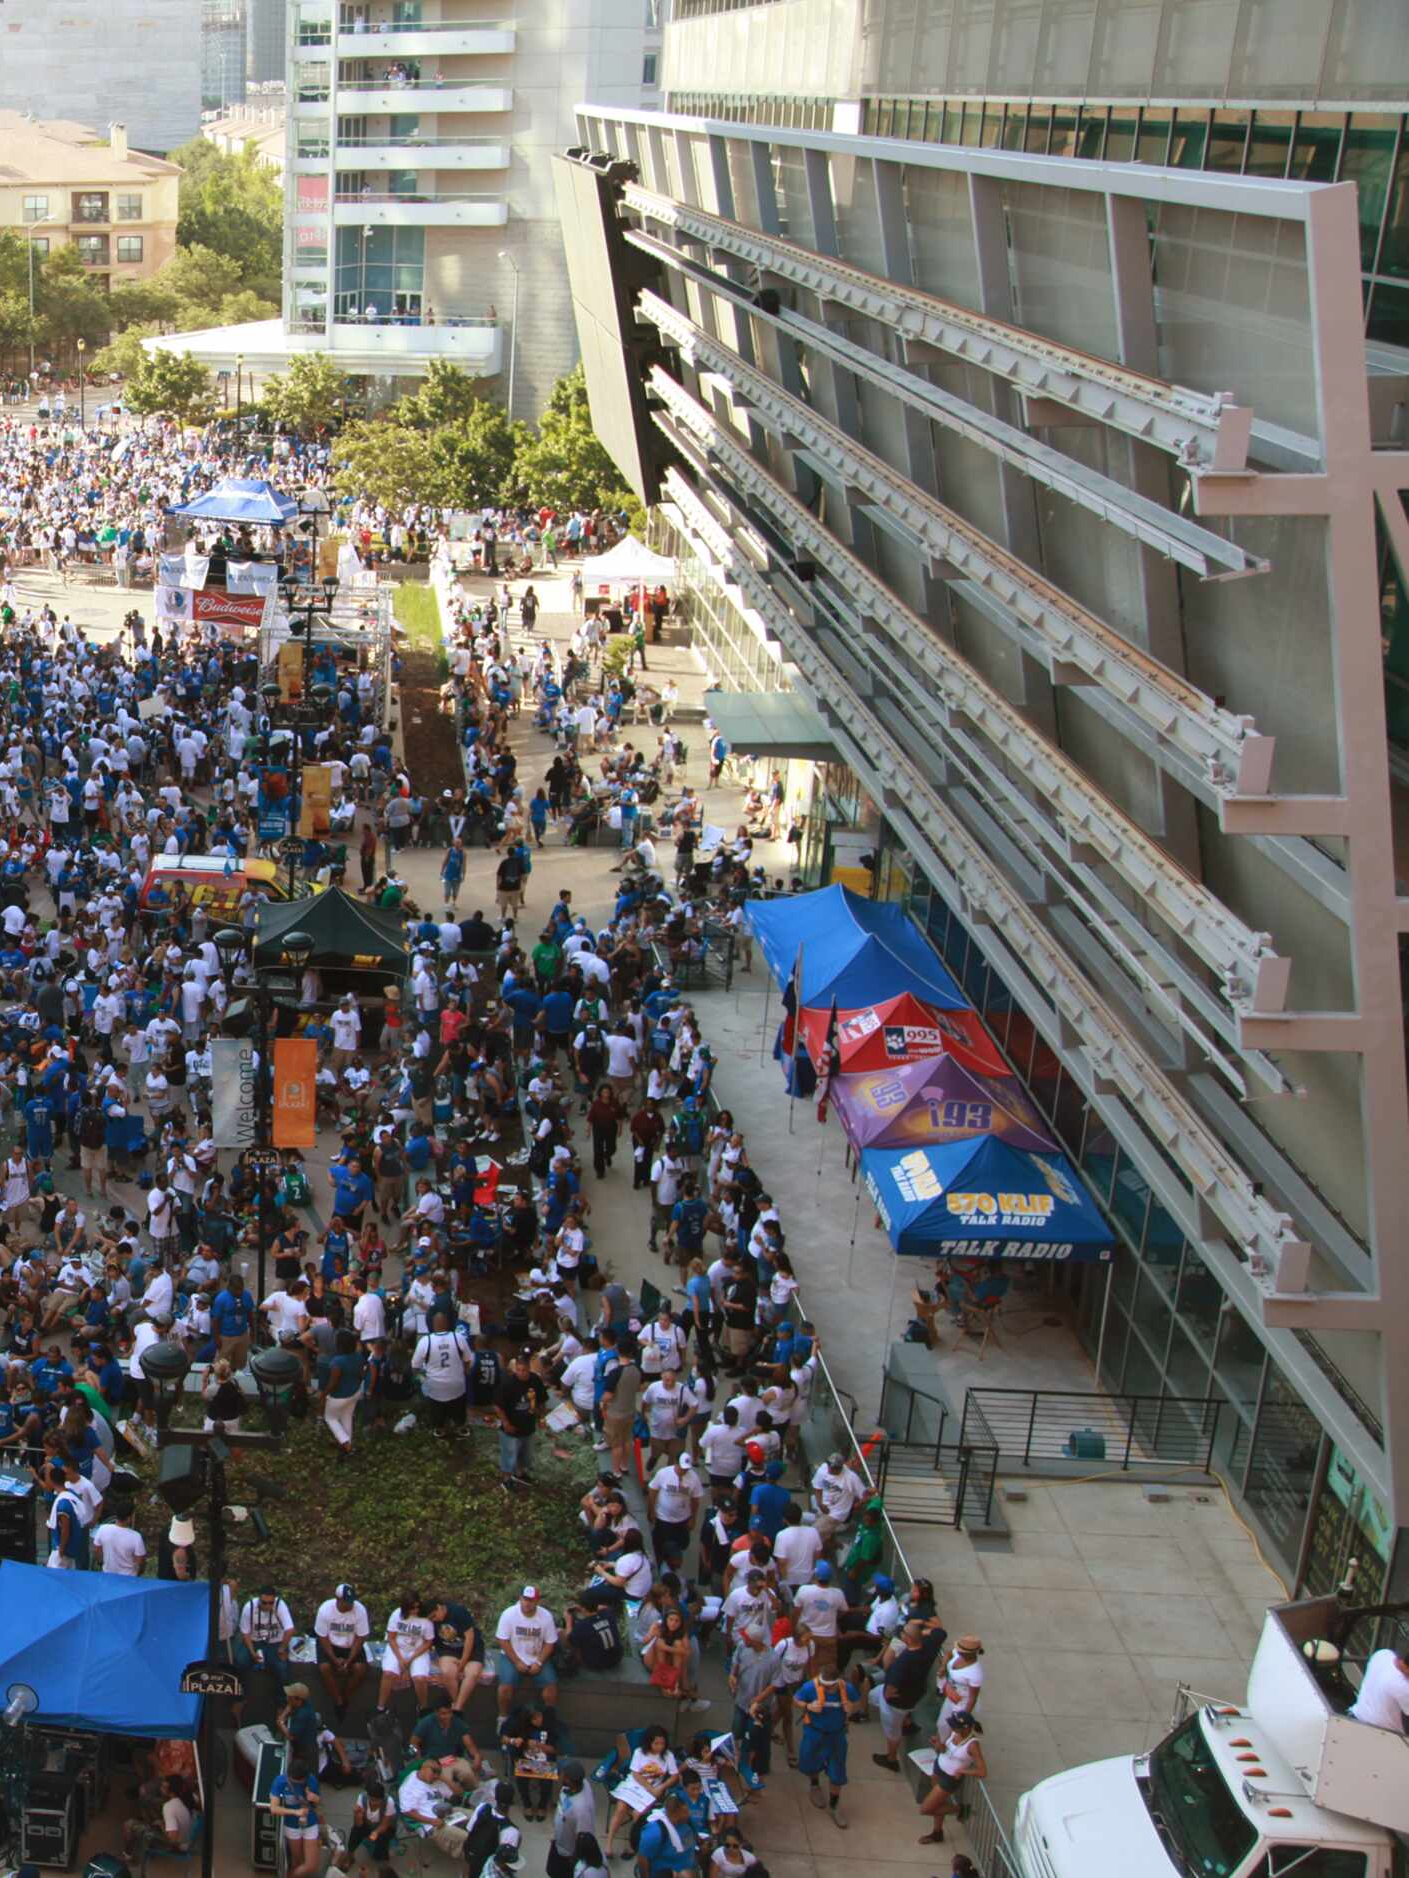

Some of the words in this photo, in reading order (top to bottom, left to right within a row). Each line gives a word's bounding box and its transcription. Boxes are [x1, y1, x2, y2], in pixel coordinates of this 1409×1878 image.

[198, 597, 265, 617] Budweise
[906, 1030, 938, 1042] 995
[237, 1048, 256, 1144] Welcome
[928, 1099, 992, 1129] i93
[248, 1156, 277, 1164] PLAZA
[946, 1193, 997, 1216] 570
[997, 1193, 1054, 1217] KLIF
[959, 1215, 997, 1225] TALK
[1001, 1215, 1047, 1227] RADIO
[940, 1241, 1000, 1257] TALK
[1001, 1243, 1073, 1260] RADIO
[440, 1351, 451, 1369] 2
[479, 1367, 496, 1386] 31
[597, 1629, 615, 1650] 11
[190, 1682, 233, 1694] PLAZA
